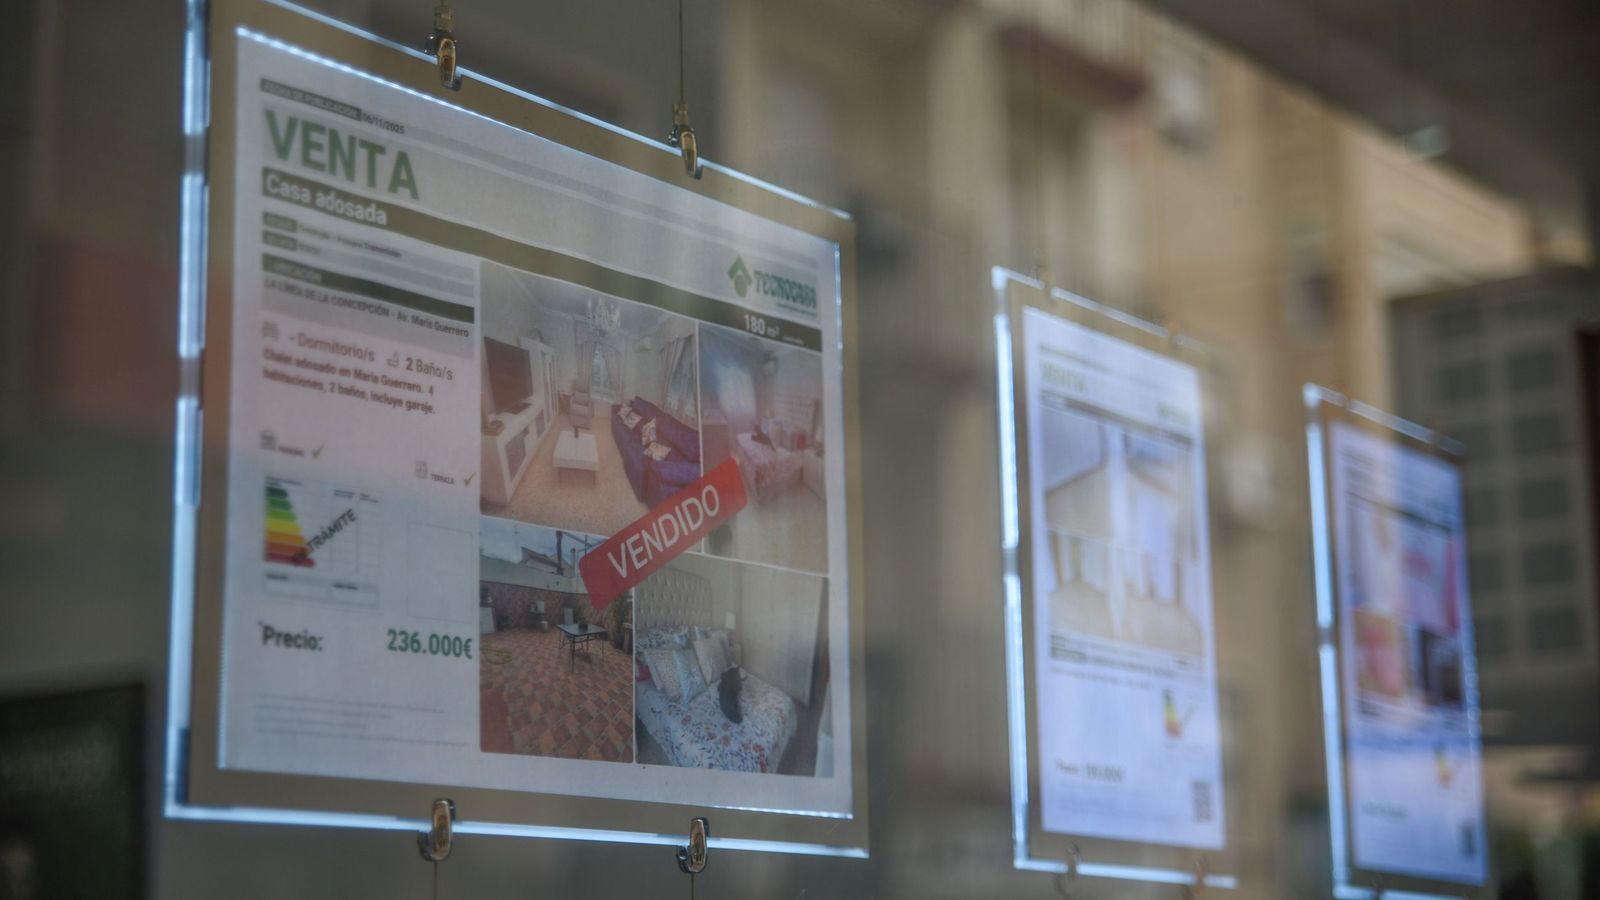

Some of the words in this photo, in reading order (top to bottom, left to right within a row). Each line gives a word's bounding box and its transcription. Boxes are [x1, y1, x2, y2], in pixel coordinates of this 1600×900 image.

[264, 109, 419, 200] VENTA
[266, 174, 310, 203] Casa
[316, 190, 387, 225] adosada
[303, 288, 314, 299] DE
[316, 290, 328, 302] LA
[434, 319, 469, 337] Guerrero
[744, 314, 765, 335] 180
[298, 333, 375, 362] Dormitorio/s
[295, 357, 336, 376] adosado
[338, 367, 351, 378] en
[428, 386, 434, 395] 4
[405, 357, 414, 371] 2
[416, 358, 453, 381] Baño/s
[329, 381, 336, 393] 2
[370, 391, 403, 409] incluye
[607, 484, 720, 579] VENDIDO
[262, 625, 323, 651] Precio:
[387, 628, 472, 660] 236.000€
